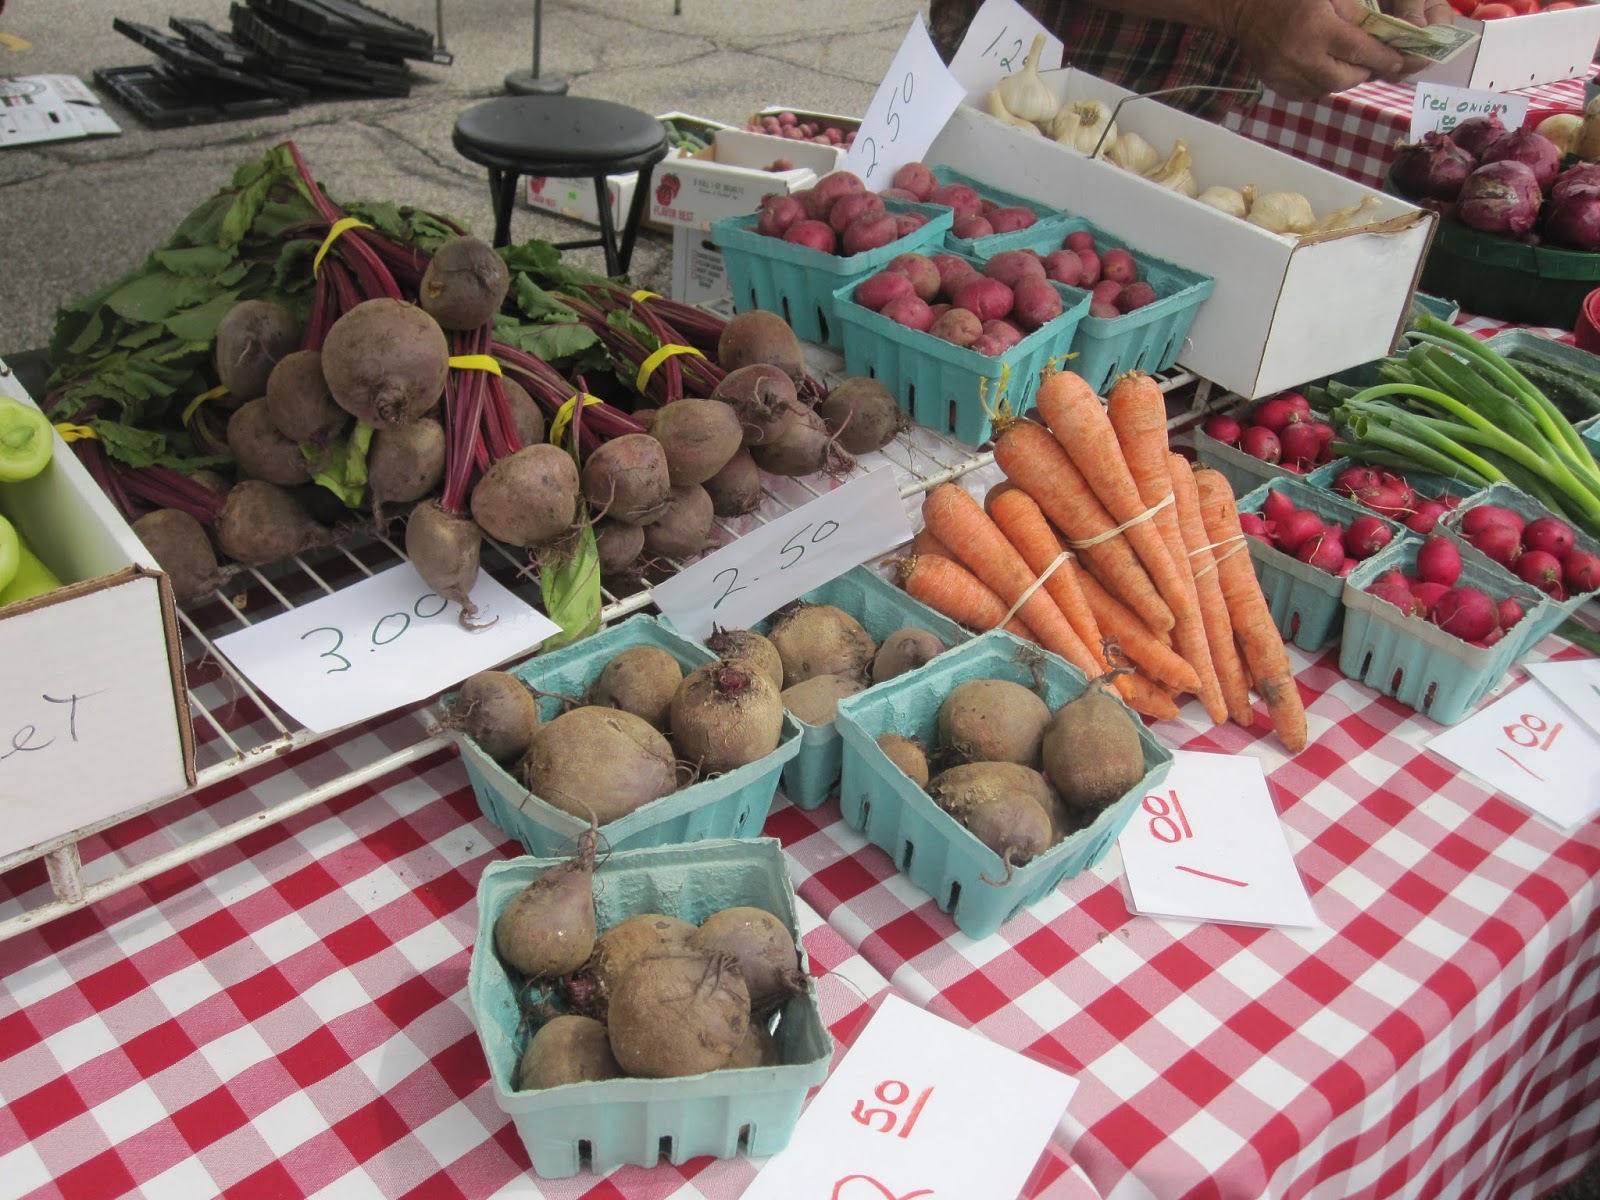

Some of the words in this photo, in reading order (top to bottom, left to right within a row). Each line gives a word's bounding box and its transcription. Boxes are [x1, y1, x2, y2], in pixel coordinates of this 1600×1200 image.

[980, 25, 1029, 74] 1.2
[860, 71, 915, 179] 2.50
[1422, 93, 1449, 111] red
[299, 593, 449, 675] 3.00
